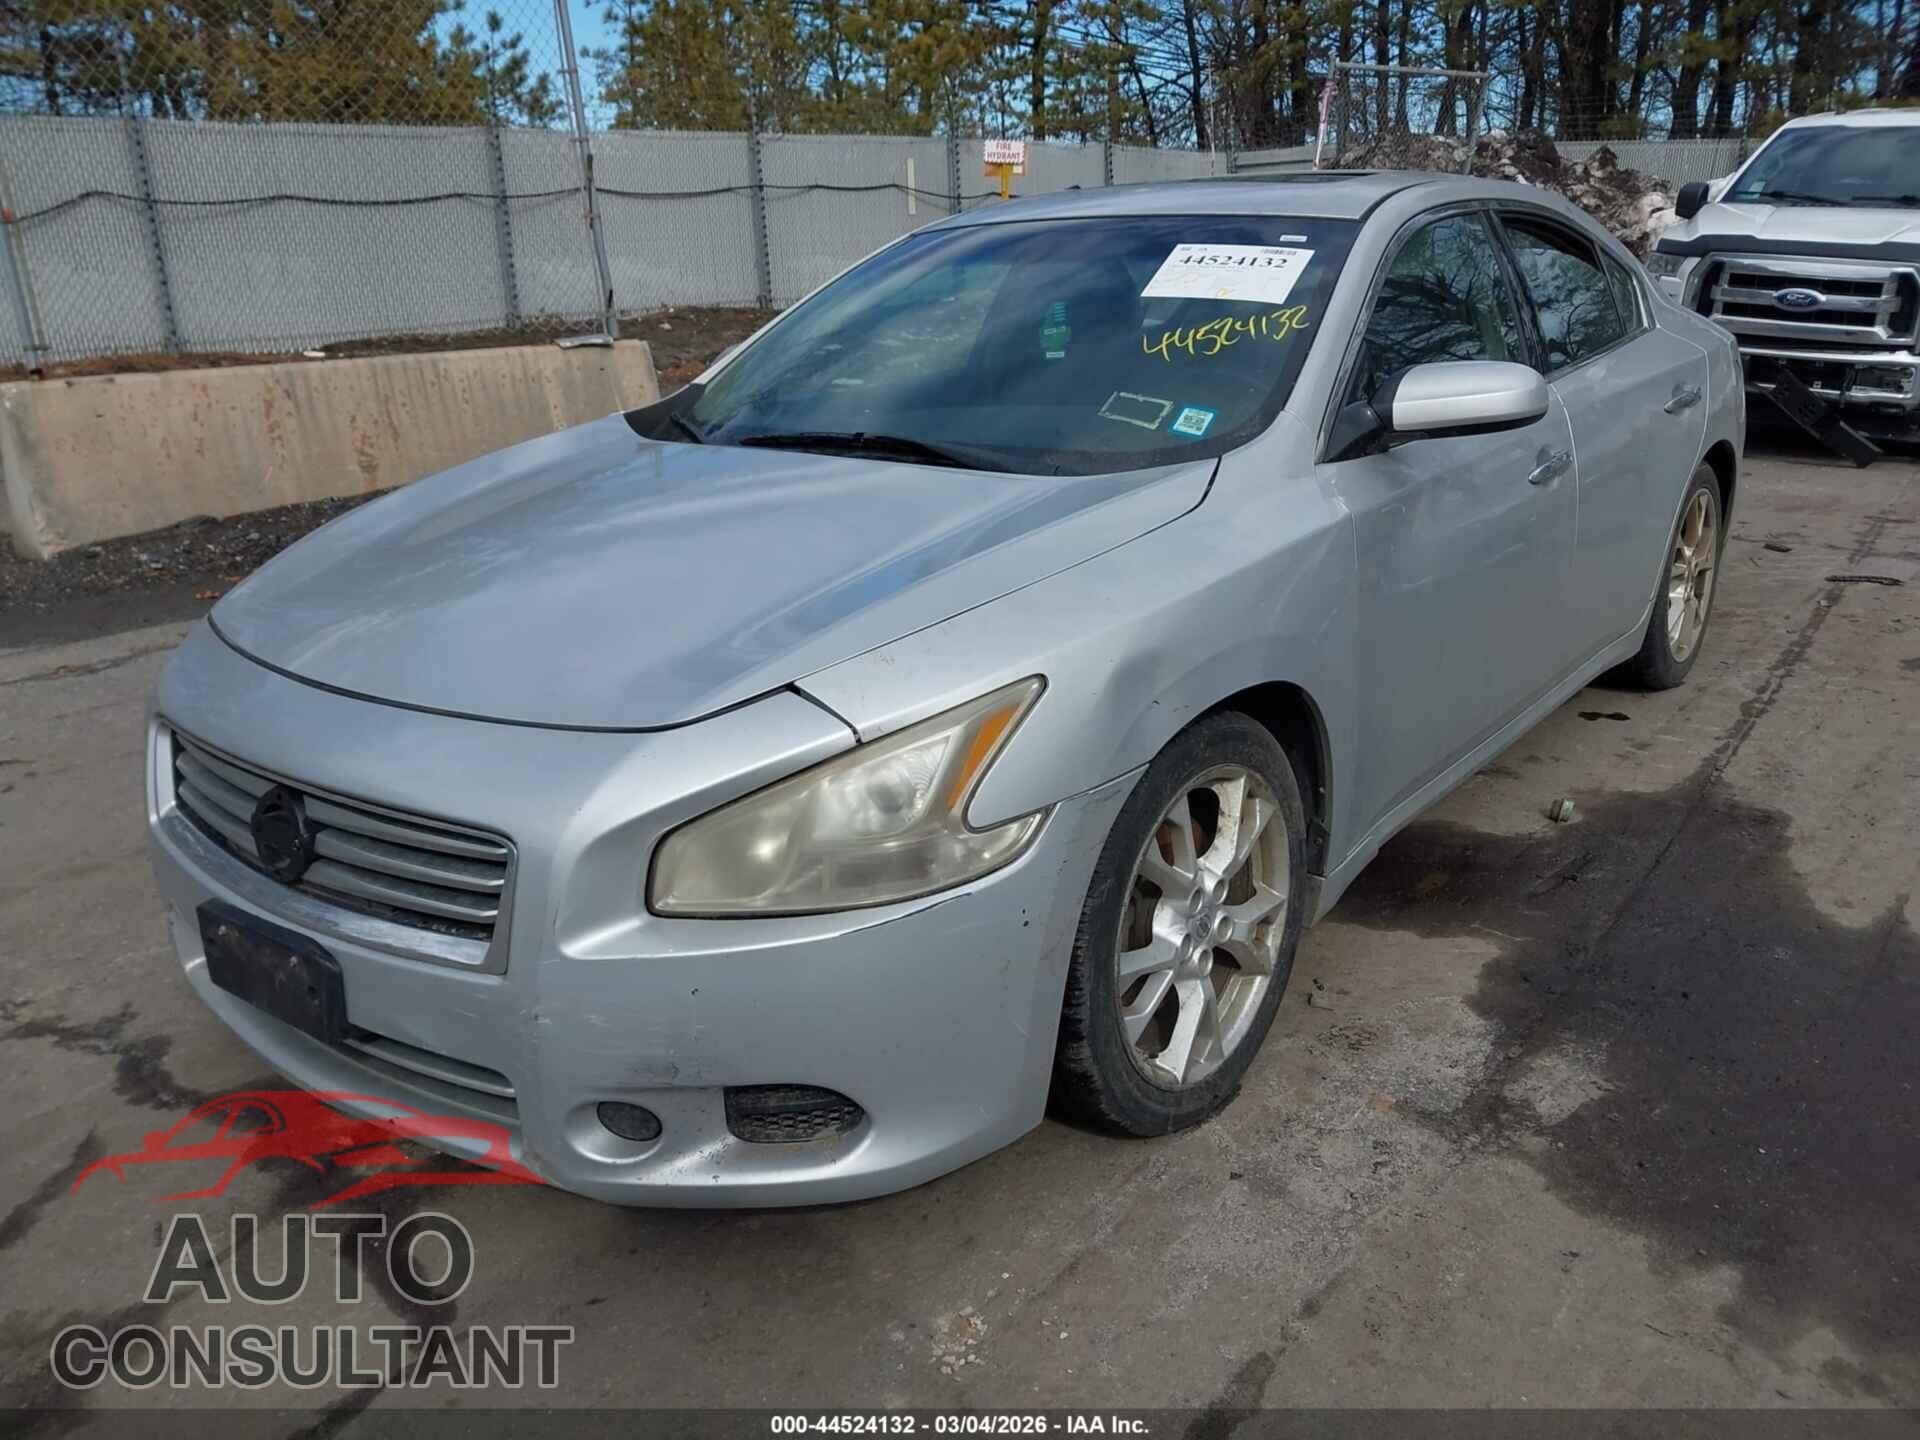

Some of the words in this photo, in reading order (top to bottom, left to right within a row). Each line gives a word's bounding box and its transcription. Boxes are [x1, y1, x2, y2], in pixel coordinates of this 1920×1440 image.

[996, 142, 1011, 150] FIRE
[986, 151, 1021, 160] HYDRANT
[1179, 255, 1288, 269] 44524132
[1143, 304, 1310, 361] 44524132
